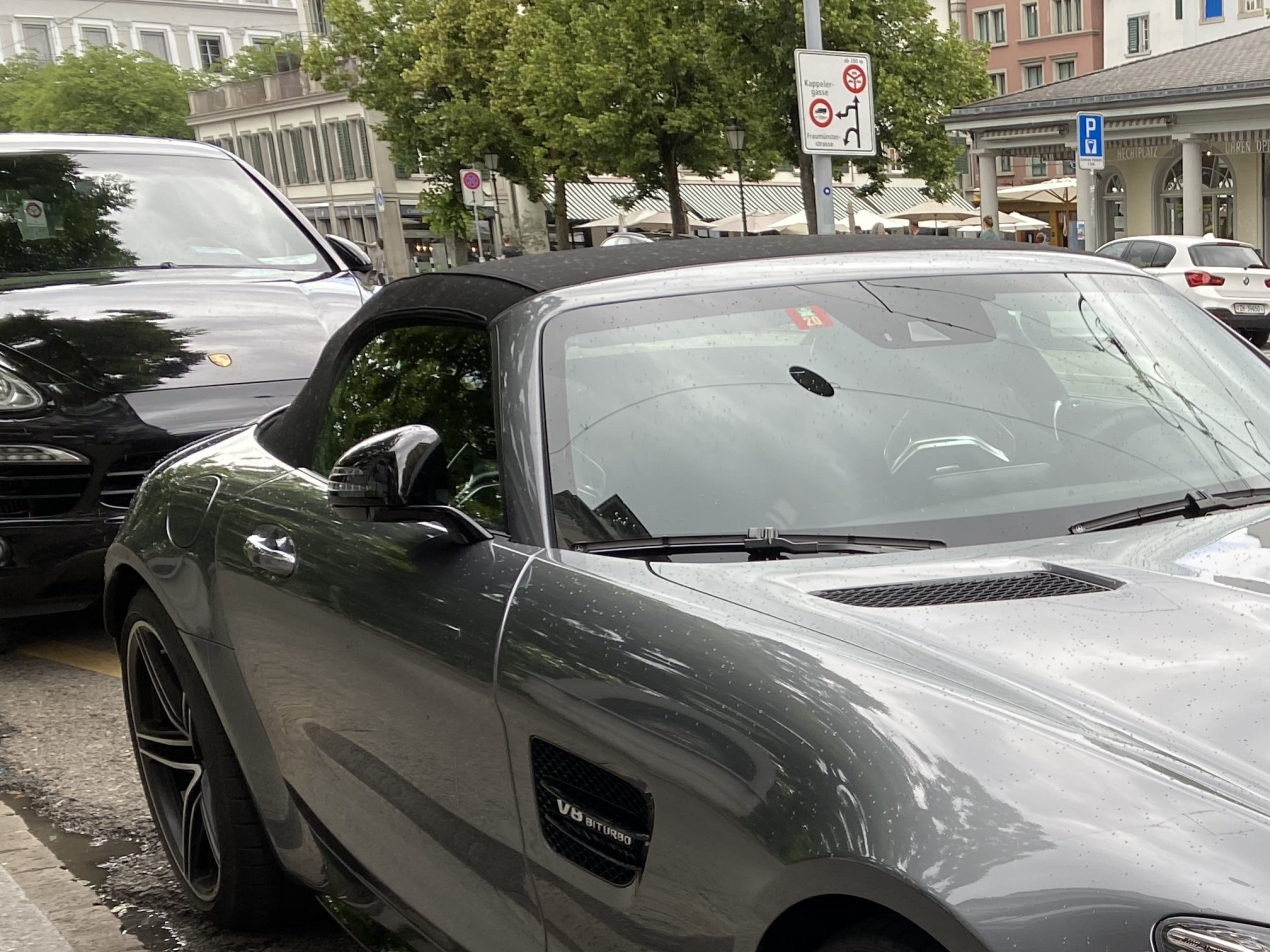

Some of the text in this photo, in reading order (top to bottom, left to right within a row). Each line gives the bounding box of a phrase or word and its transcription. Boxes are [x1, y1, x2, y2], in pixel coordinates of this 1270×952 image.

[804, 80, 834, 88] Kappeler-
[811, 89, 829, 97] gasse
[1085, 118, 1096, 138] P
[1117, 146, 1158, 159] HECHTPLATZ
[1225, 141, 1251, 153] UHREN
[803, 315, 822, 327] 20
[557, 798, 632, 845] V8 BITURBO
